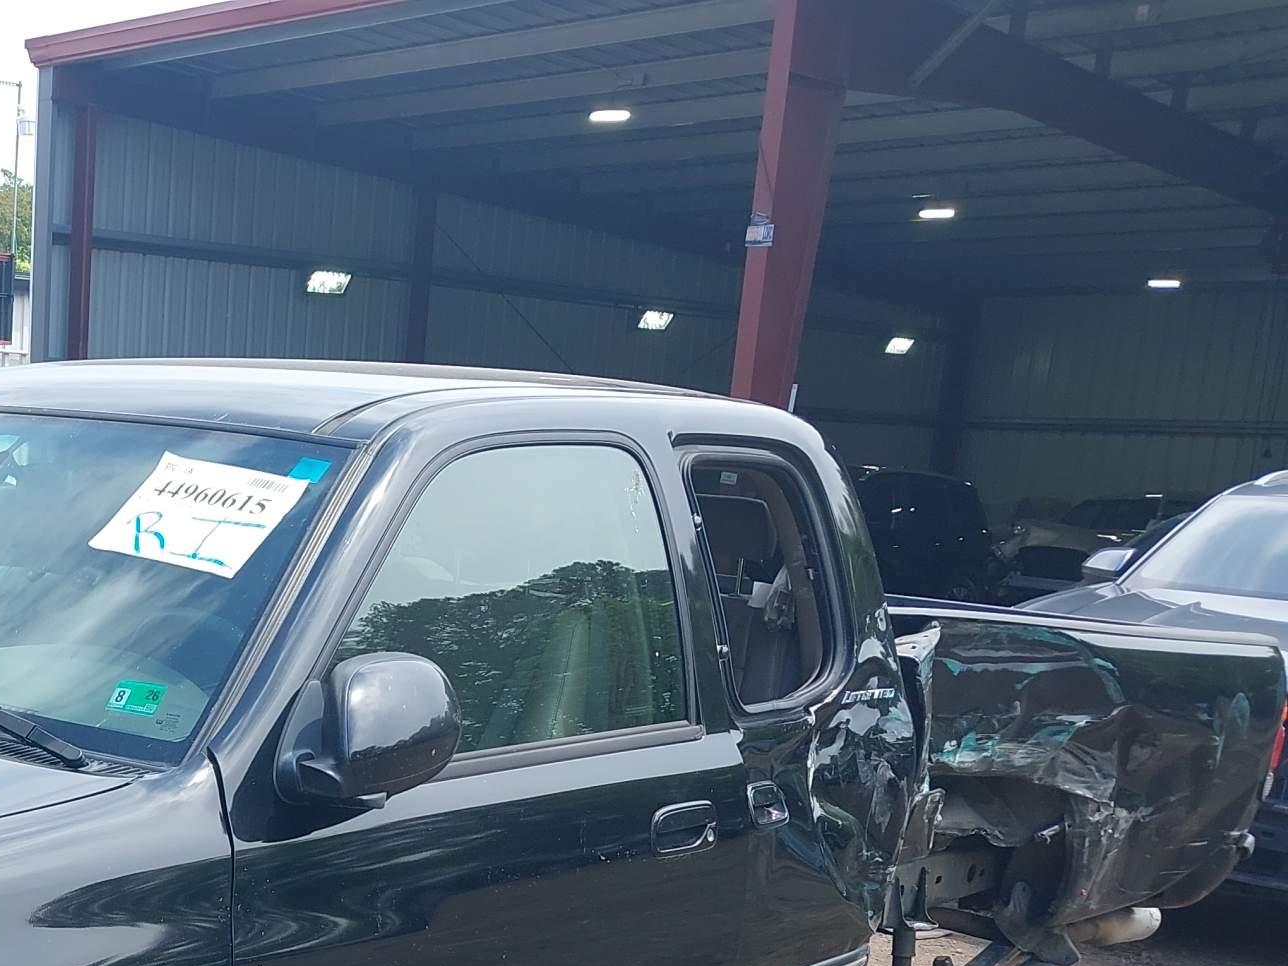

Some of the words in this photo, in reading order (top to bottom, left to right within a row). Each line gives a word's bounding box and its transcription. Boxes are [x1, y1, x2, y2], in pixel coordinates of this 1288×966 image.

[153, 480, 272, 515] 44960615
[114, 690, 126, 703] 8
[145, 689, 160, 702] 26
